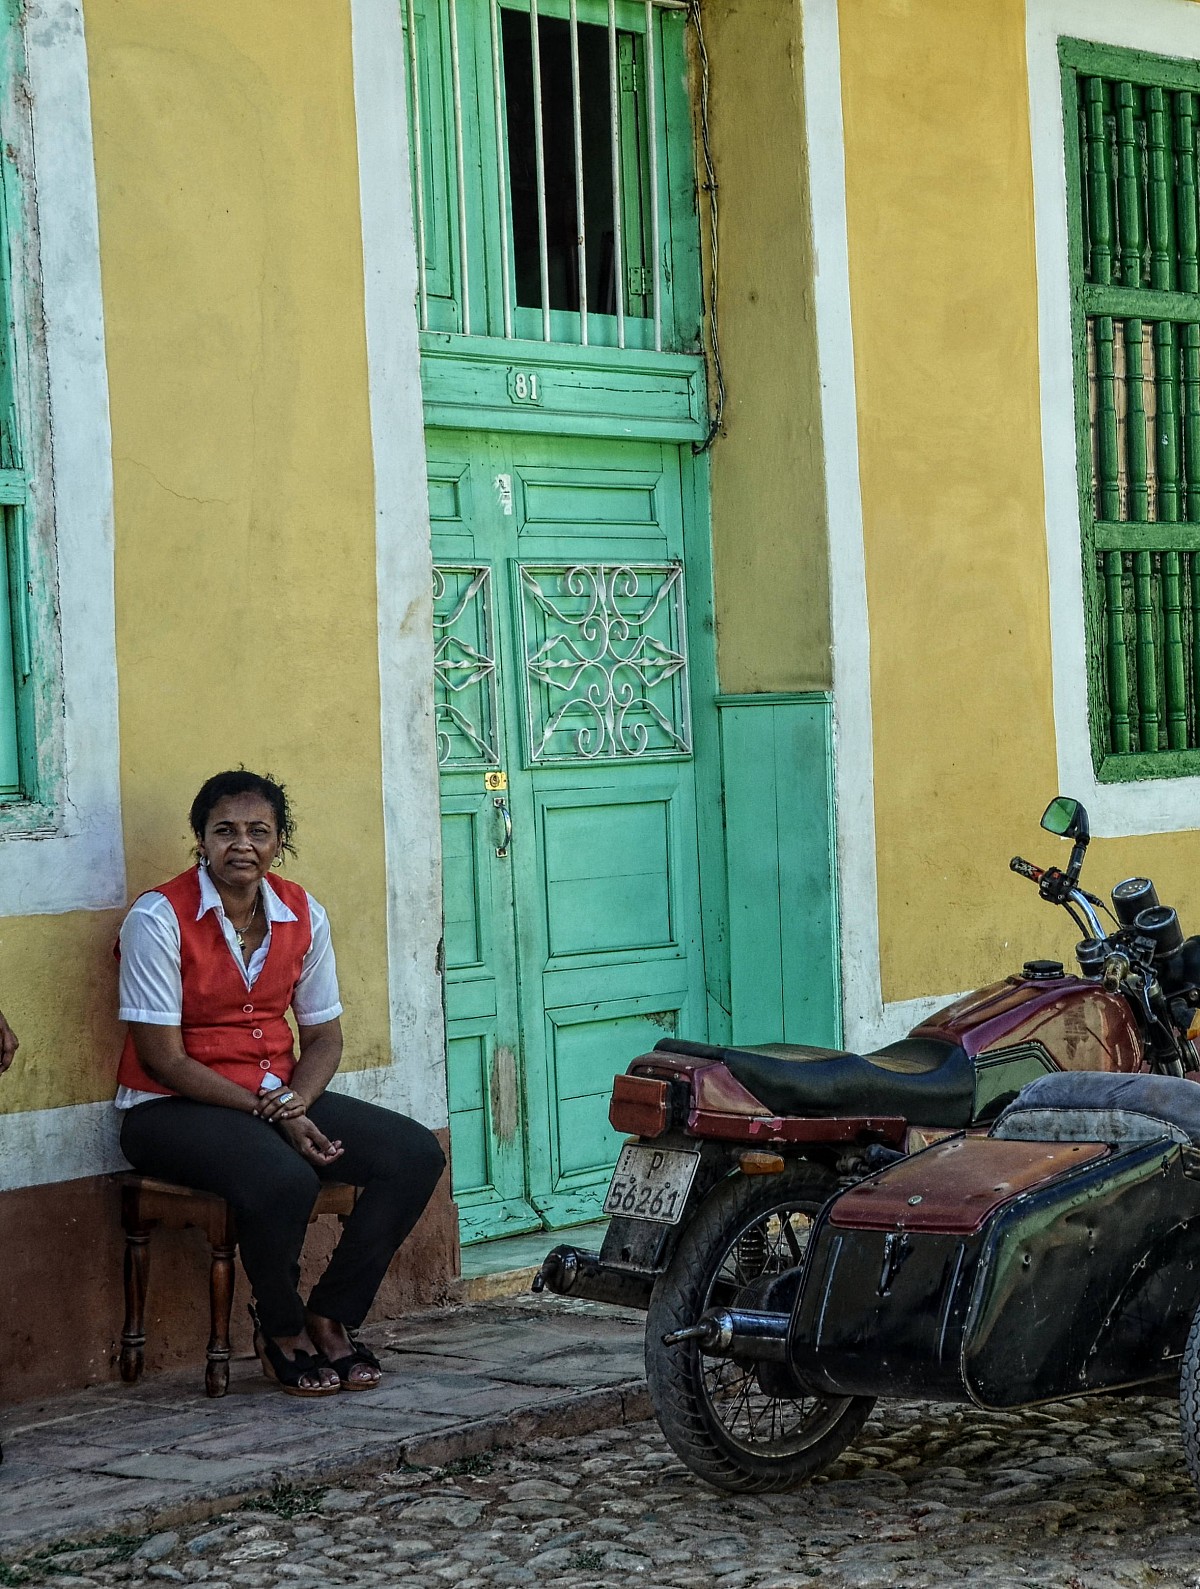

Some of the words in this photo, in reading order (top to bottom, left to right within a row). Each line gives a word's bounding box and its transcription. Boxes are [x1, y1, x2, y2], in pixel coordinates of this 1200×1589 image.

[515, 373, 537, 400] 81
[647, 1151, 663, 1179] P
[608, 1182, 679, 1218] 56261
